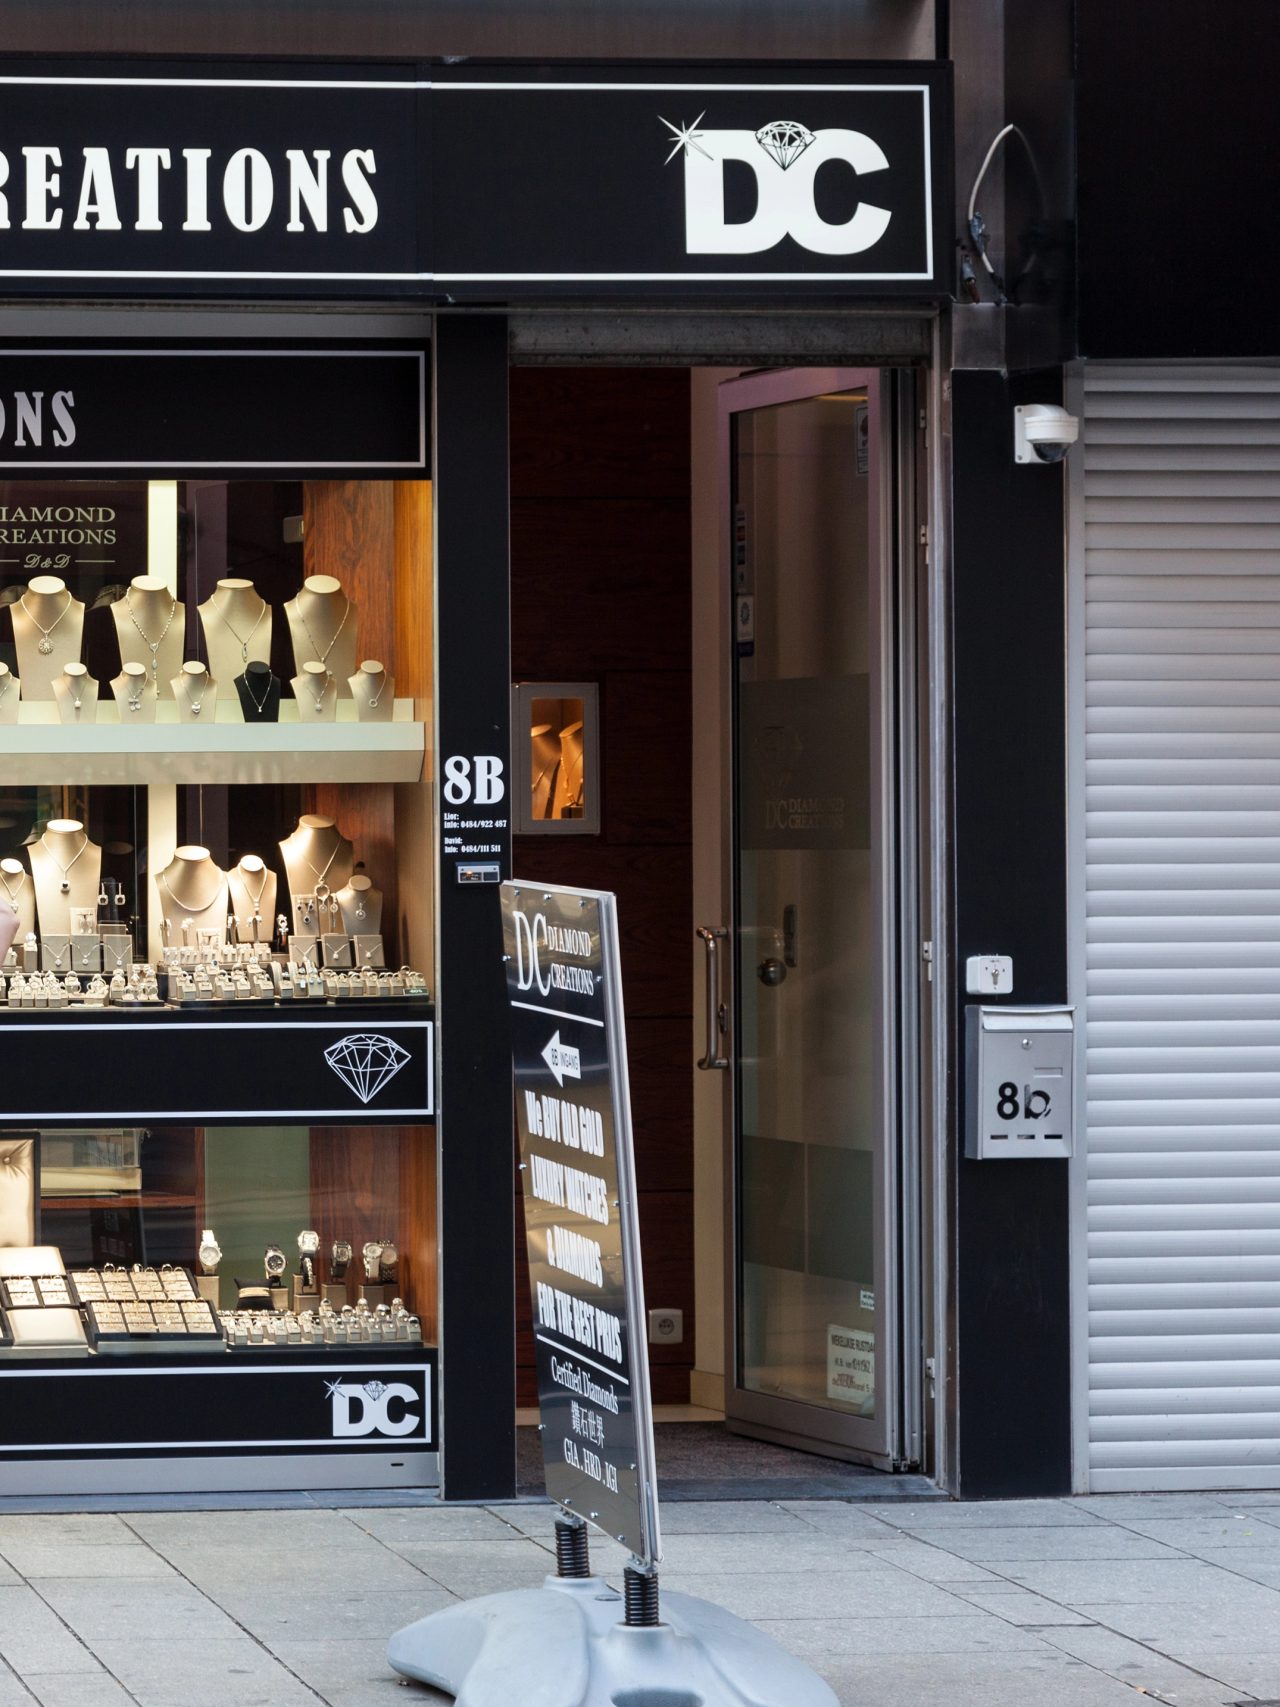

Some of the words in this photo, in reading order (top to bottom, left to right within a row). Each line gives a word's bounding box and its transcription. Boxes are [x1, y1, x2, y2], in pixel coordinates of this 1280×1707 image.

[684, 127, 892, 256] DC
[443, 755, 505, 805] 8B
[443, 820, 460, 829] Info:
[444, 845, 459, 854] Info:
[513, 911, 551, 997] DC
[547, 925, 592, 957] DIAMOND
[550, 962, 595, 997] CREATIONS
[560, 1051, 579, 1070] INGANG
[524, 1090, 543, 1137] We
[541, 1095, 561, 1143] BUY
[561, 1100, 580, 1149] OLD
[579, 1105, 605, 1157] GOLD
[530, 1153, 565, 1207] LUXURY
[564, 1165, 609, 1226] WATCHES
[546, 1228, 556, 1266] &
[554, 1225, 604, 1288] DIAMONDS
[537, 1281, 557, 1331] FOR
[554, 1289, 575, 1340] THE
[572, 1296, 597, 1350] BEST
[332, 1382, 420, 1437] DC
[551, 1355, 583, 1394] Certified
[582, 1370, 619, 1415] Diamonds
[563, 1437, 579, 1470] GIA
[582, 1448, 602, 1481] HRD
[604, 1461, 619, 1494] IGI
